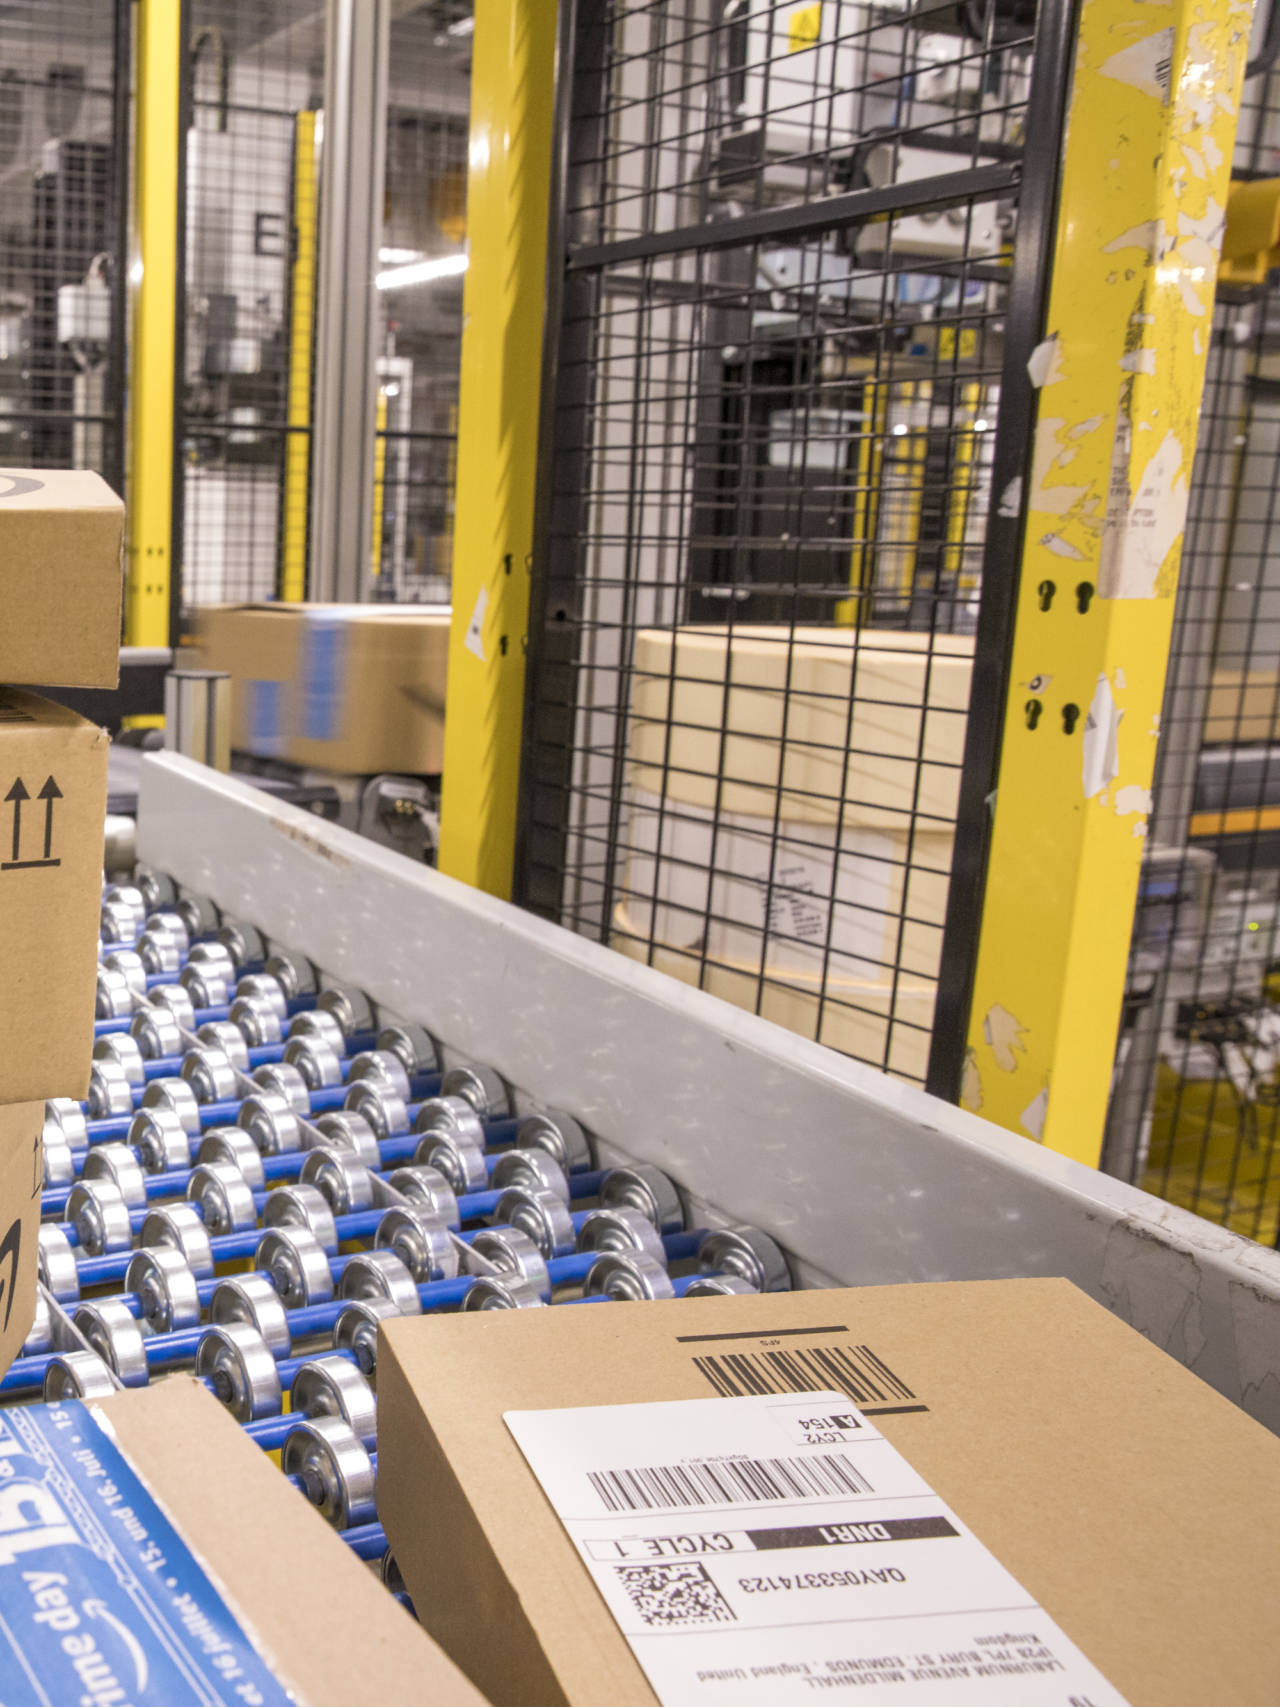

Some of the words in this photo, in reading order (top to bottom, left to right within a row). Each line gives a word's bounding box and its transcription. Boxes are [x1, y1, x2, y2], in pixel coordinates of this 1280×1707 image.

[49, 1409, 72, 1430] 15
[798, 1417, 835, 1430] 154
[803, 1431, 848, 1444] LCY2
[72, 1448, 107, 1478] Juli
[97, 1478, 123, 1507] 16.
[111, 1506, 148, 1542] und
[818, 1522, 893, 1544] DNR1
[612, 1540, 631, 1558] 1
[642, 1532, 736, 1556] CYCLE
[139, 1540, 167, 1573] 15.
[737, 1567, 908, 1594] QAY053374123
[22, 1571, 81, 1631] day
[172, 1592, 233, 1655] juillet
[973, 1632, 1042, 1647] Kingdom
[211, 1654, 244, 1681] 16
[824, 1654, 906, 1674] EDMUNDS
[937, 1651, 983, 1665] BURY
[695, 1667, 749, 1683] United
[749, 1661, 813, 1679] England
[802, 1669, 906, 1688] MILDENHALL
[907, 1666, 971, 1682] AVENUE
[974, 1659, 1067, 1678] LABURNUM
